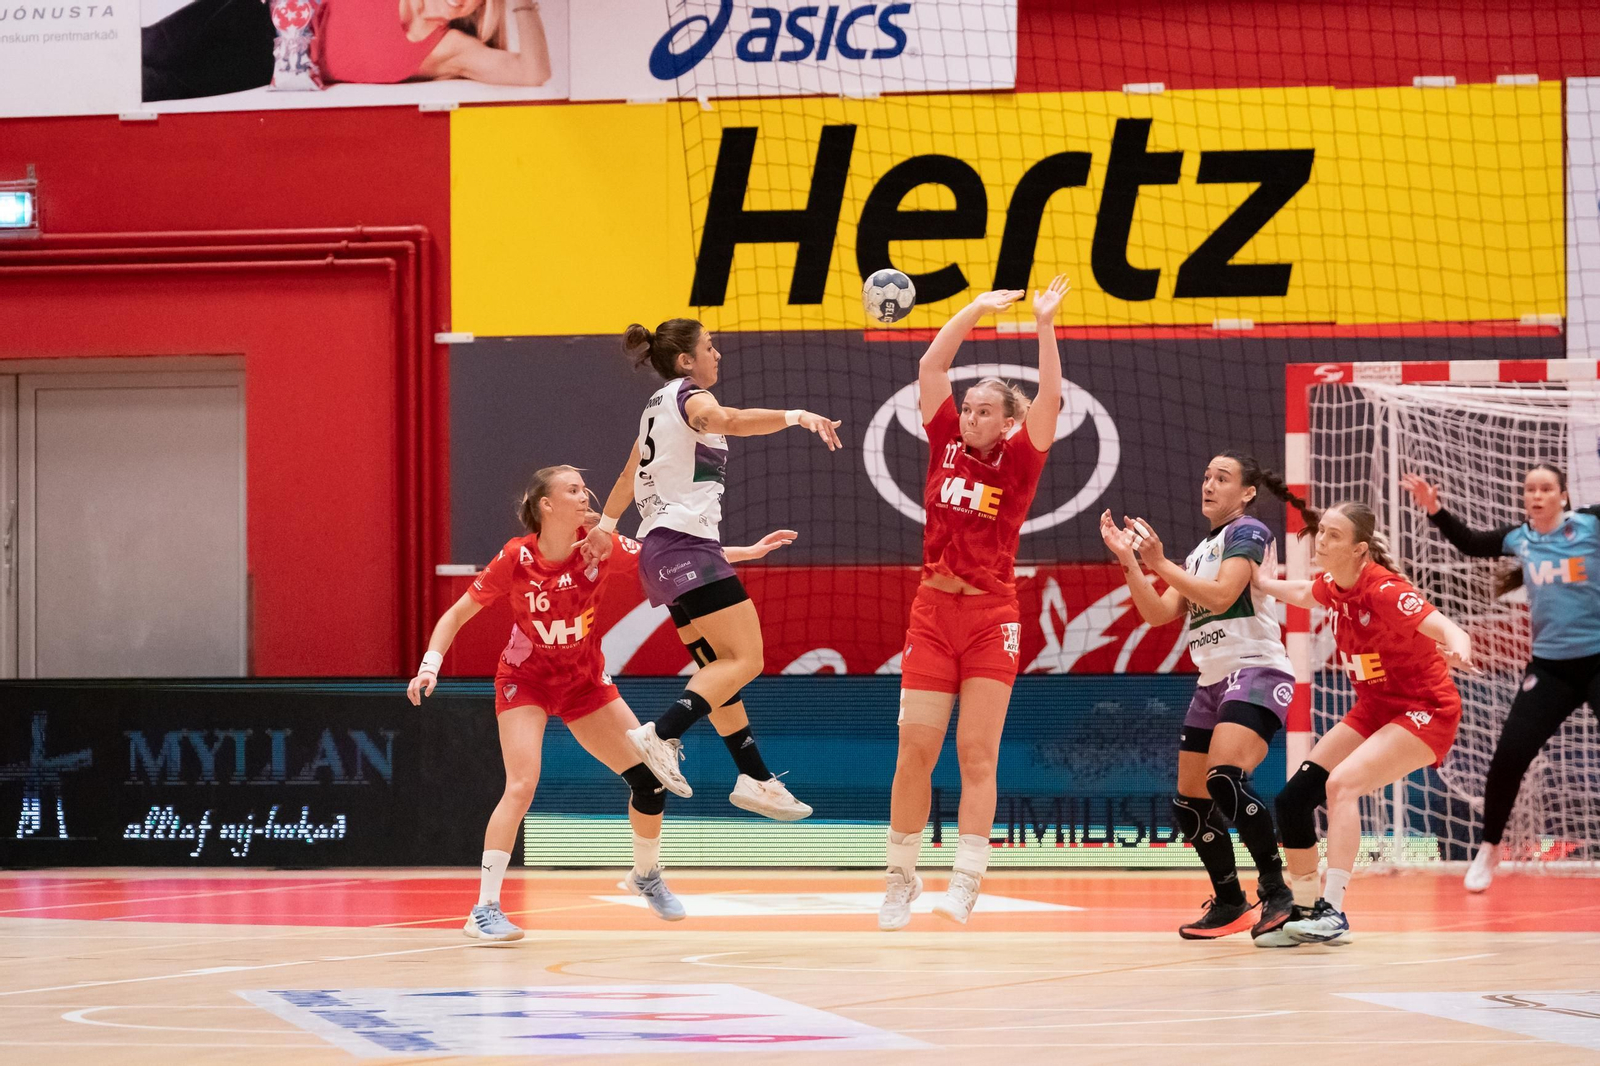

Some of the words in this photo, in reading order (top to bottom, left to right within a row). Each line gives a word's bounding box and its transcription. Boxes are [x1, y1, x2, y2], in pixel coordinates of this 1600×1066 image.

[689, 118, 1315, 307] Hertz
[940, 476, 1003, 516] VHE
[1528, 556, 1588, 585] VHE
[524, 591, 550, 613] 16
[532, 606, 595, 645] VHE
